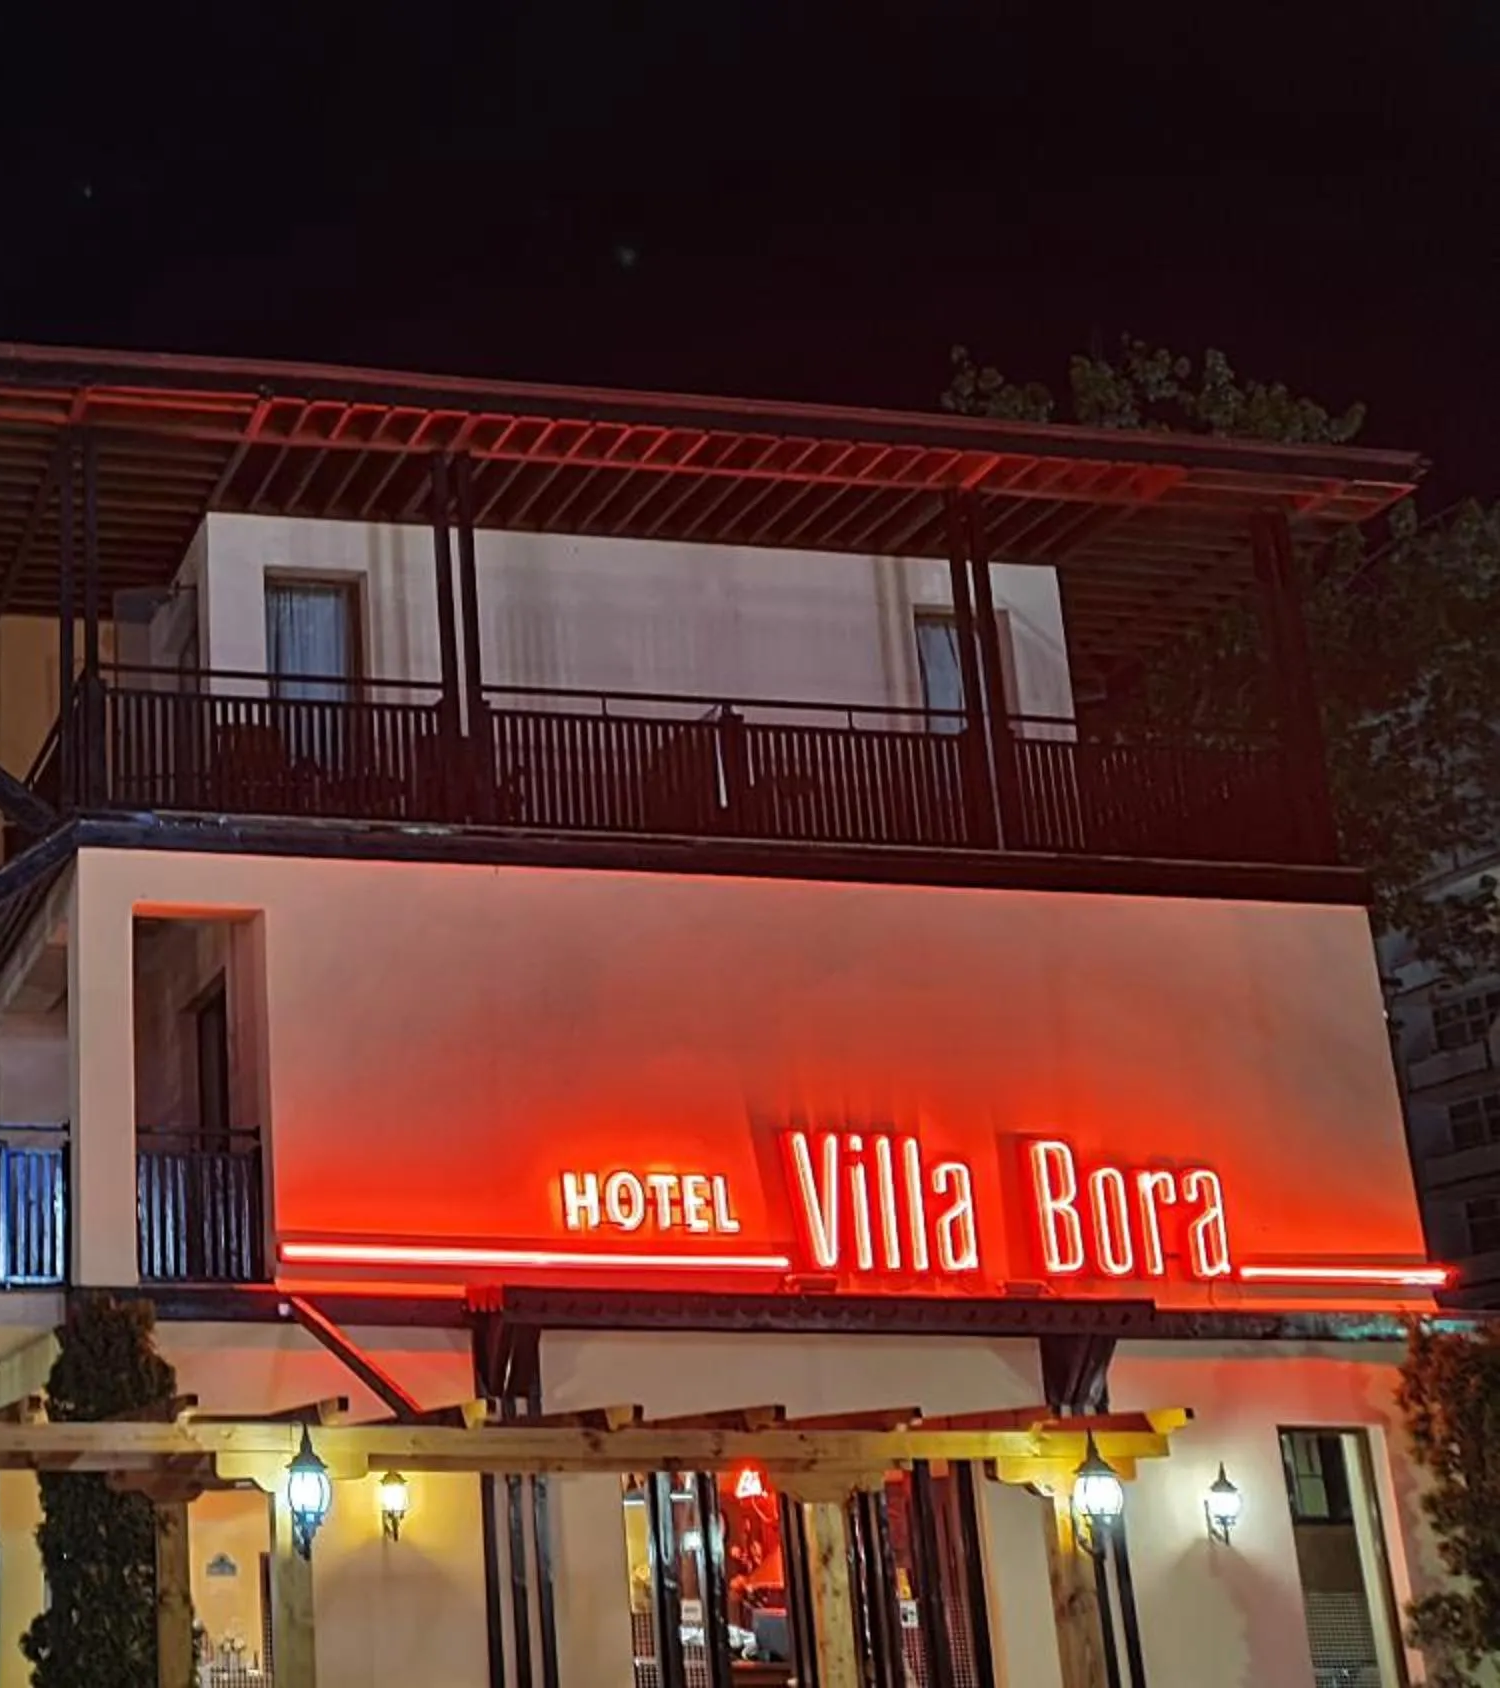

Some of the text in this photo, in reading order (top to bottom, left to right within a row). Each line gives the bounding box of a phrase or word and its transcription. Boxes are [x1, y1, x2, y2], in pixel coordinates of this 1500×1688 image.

[562, 1131, 1232, 1278] HOTEL Villa Bora
